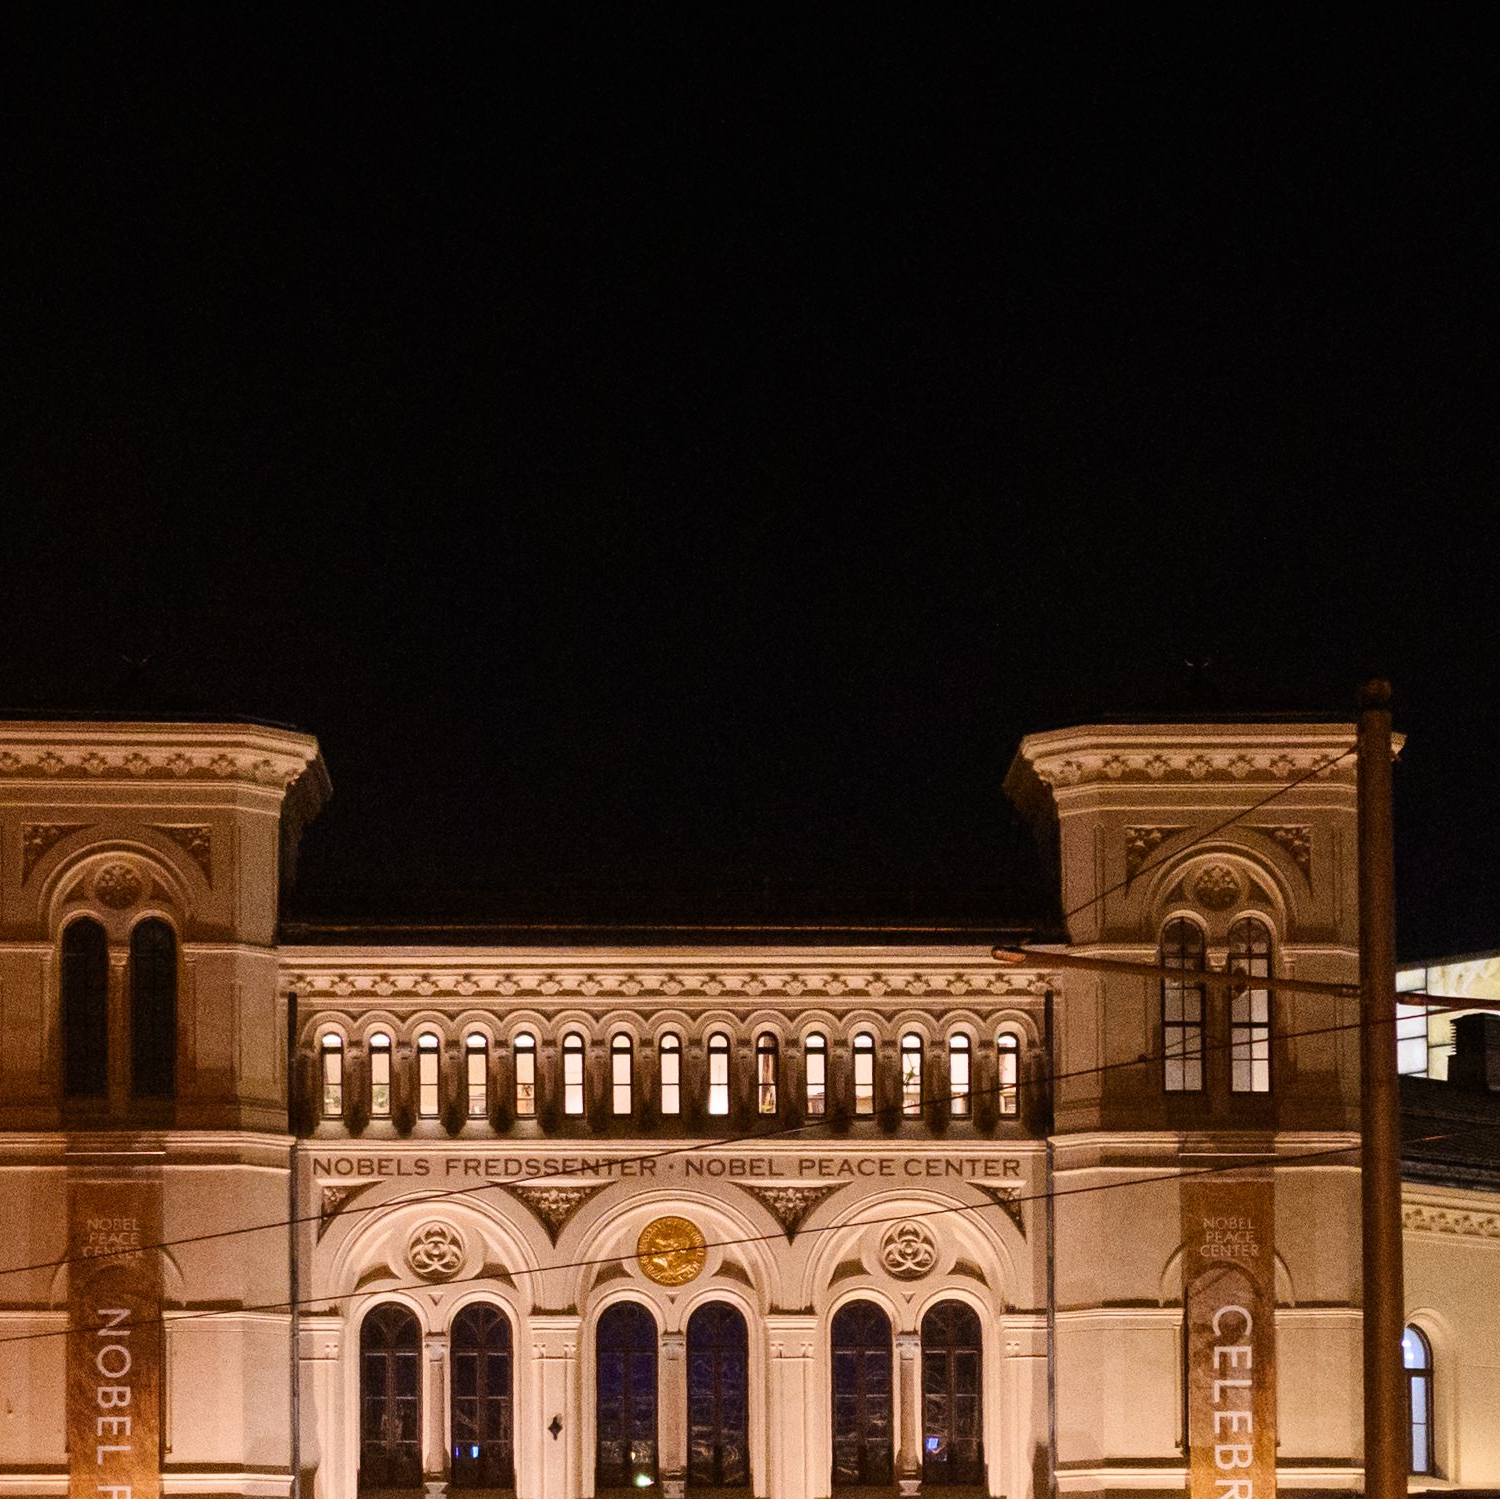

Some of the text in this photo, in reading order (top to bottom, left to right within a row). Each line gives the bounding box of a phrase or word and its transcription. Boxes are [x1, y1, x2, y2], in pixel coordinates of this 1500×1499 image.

[312, 1158, 1021, 1177] NOBELS FREDSSENTER NOBEL PEACE CENTER
[86, 1218, 140, 1231] NOBEL
[1203, 1217, 1256, 1229] NOBEL
[89, 1232, 140, 1245] PEACE
[1206, 1231, 1256, 1243] PEACE
[1200, 1244, 1260, 1257] CENTER
[96, 1308, 132, 1465] NOBEL
